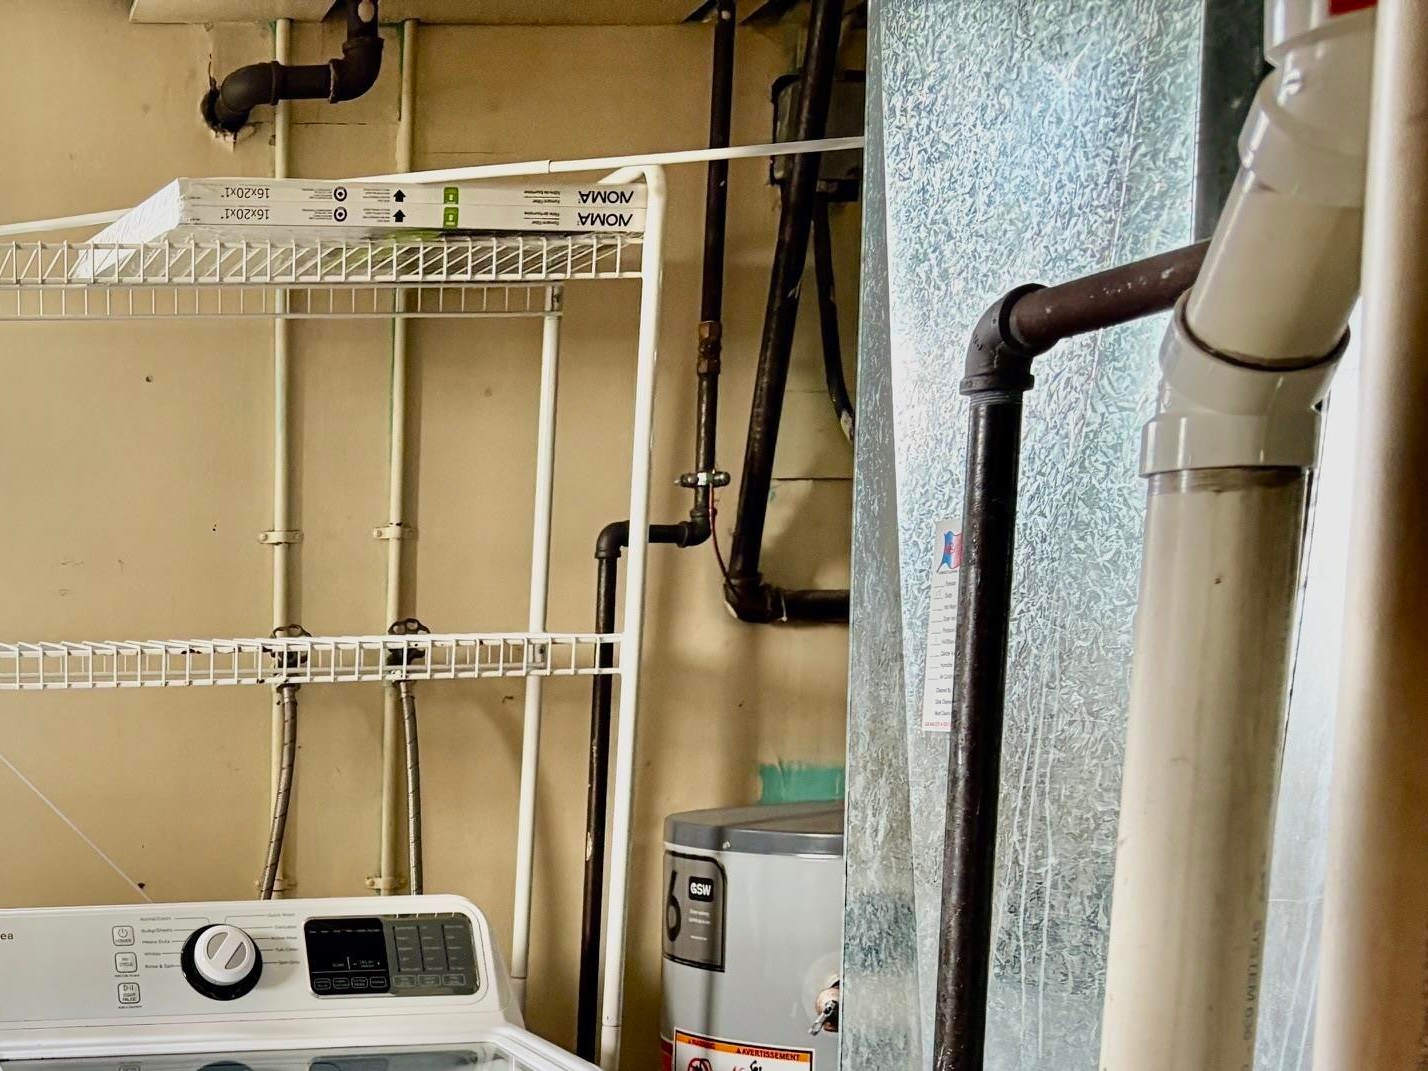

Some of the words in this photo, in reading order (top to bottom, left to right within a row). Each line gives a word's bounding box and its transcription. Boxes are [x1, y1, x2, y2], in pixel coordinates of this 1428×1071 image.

[577, 190, 634, 204] NOMA
[577, 212, 634, 227] NOMA
[690, 881, 712, 897] GSW
[742, 1048, 801, 1062] AVERTISSEMENT
